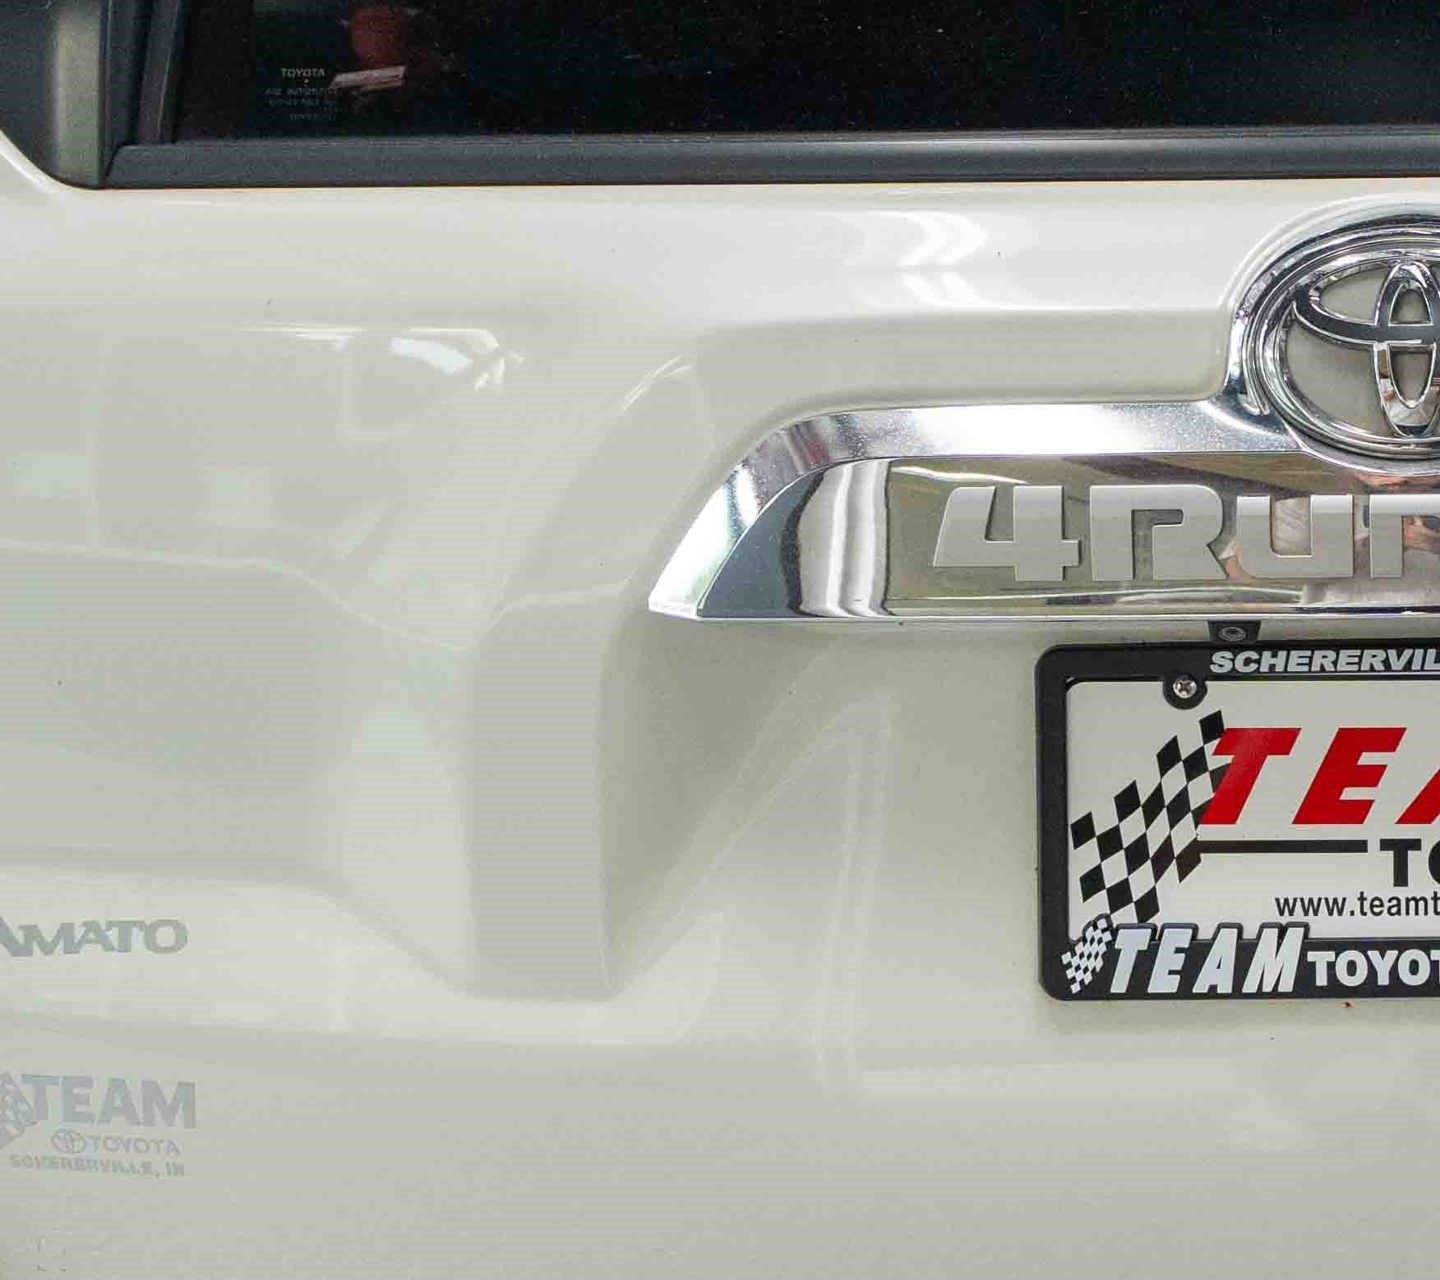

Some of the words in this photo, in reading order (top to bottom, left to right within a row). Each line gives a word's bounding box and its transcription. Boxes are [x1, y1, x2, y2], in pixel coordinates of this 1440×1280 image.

[280, 67, 326, 78] TOYOTA
[20, 1073, 197, 1129] TEAM
[83, 1135, 181, 1156] TOYOTA
